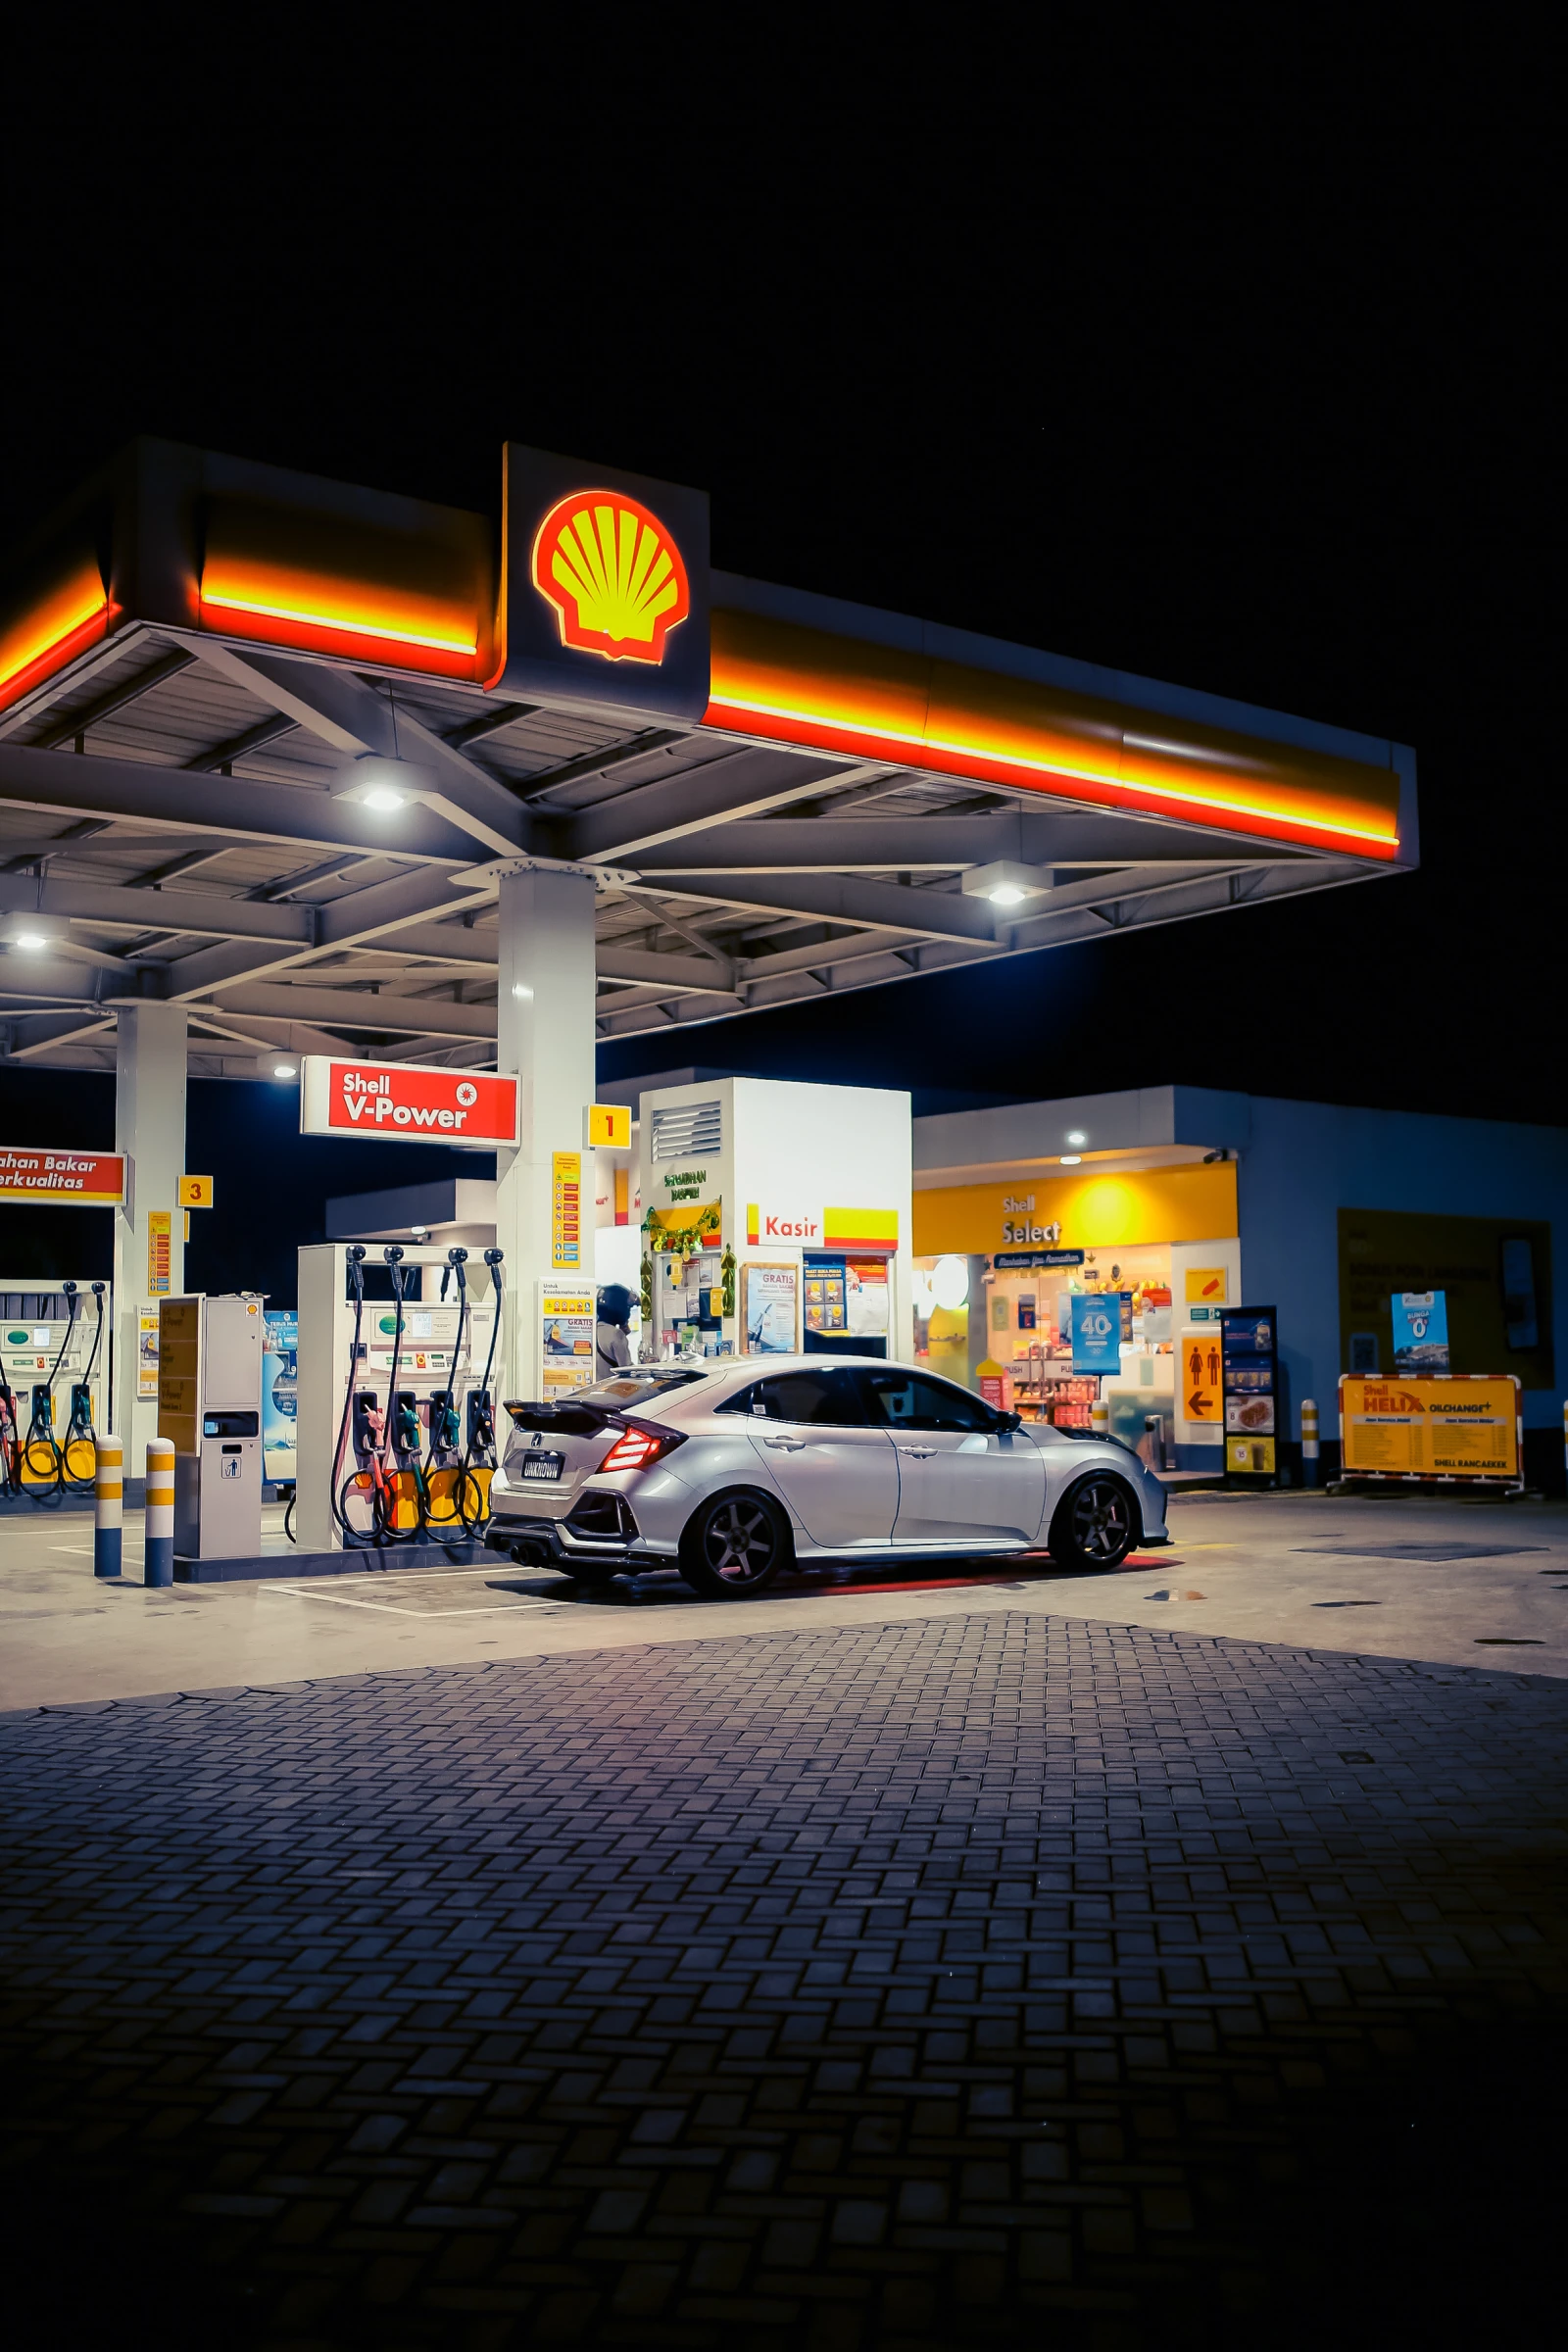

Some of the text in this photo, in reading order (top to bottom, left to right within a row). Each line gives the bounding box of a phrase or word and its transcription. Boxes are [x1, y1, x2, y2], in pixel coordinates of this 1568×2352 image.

[343, 1073, 390, 1095] Shell
[343, 1094, 467, 1129] V-Power
[606, 1115, 613, 1137] 1
[44, 1156, 96, 1172] Bakar
[189, 1183, 202, 1200] 3
[1003, 1195, 1035, 1213] Shell
[766, 1216, 817, 1237] Kasir
[1002, 1219, 1060, 1244] Select
[762, 1274, 794, 1284] GRATIS
[1407, 1310, 1430, 1320] BUNGA
[1363, 1385, 1388, 1396] Shell
[1363, 1396, 1425, 1412] HELIX
[1230, 1411, 1235, 1420] 8
[524, 1461, 559, 1478] UNKNOWN
[1435, 1458, 1507, 1469] SHELL RANCAEKEK
